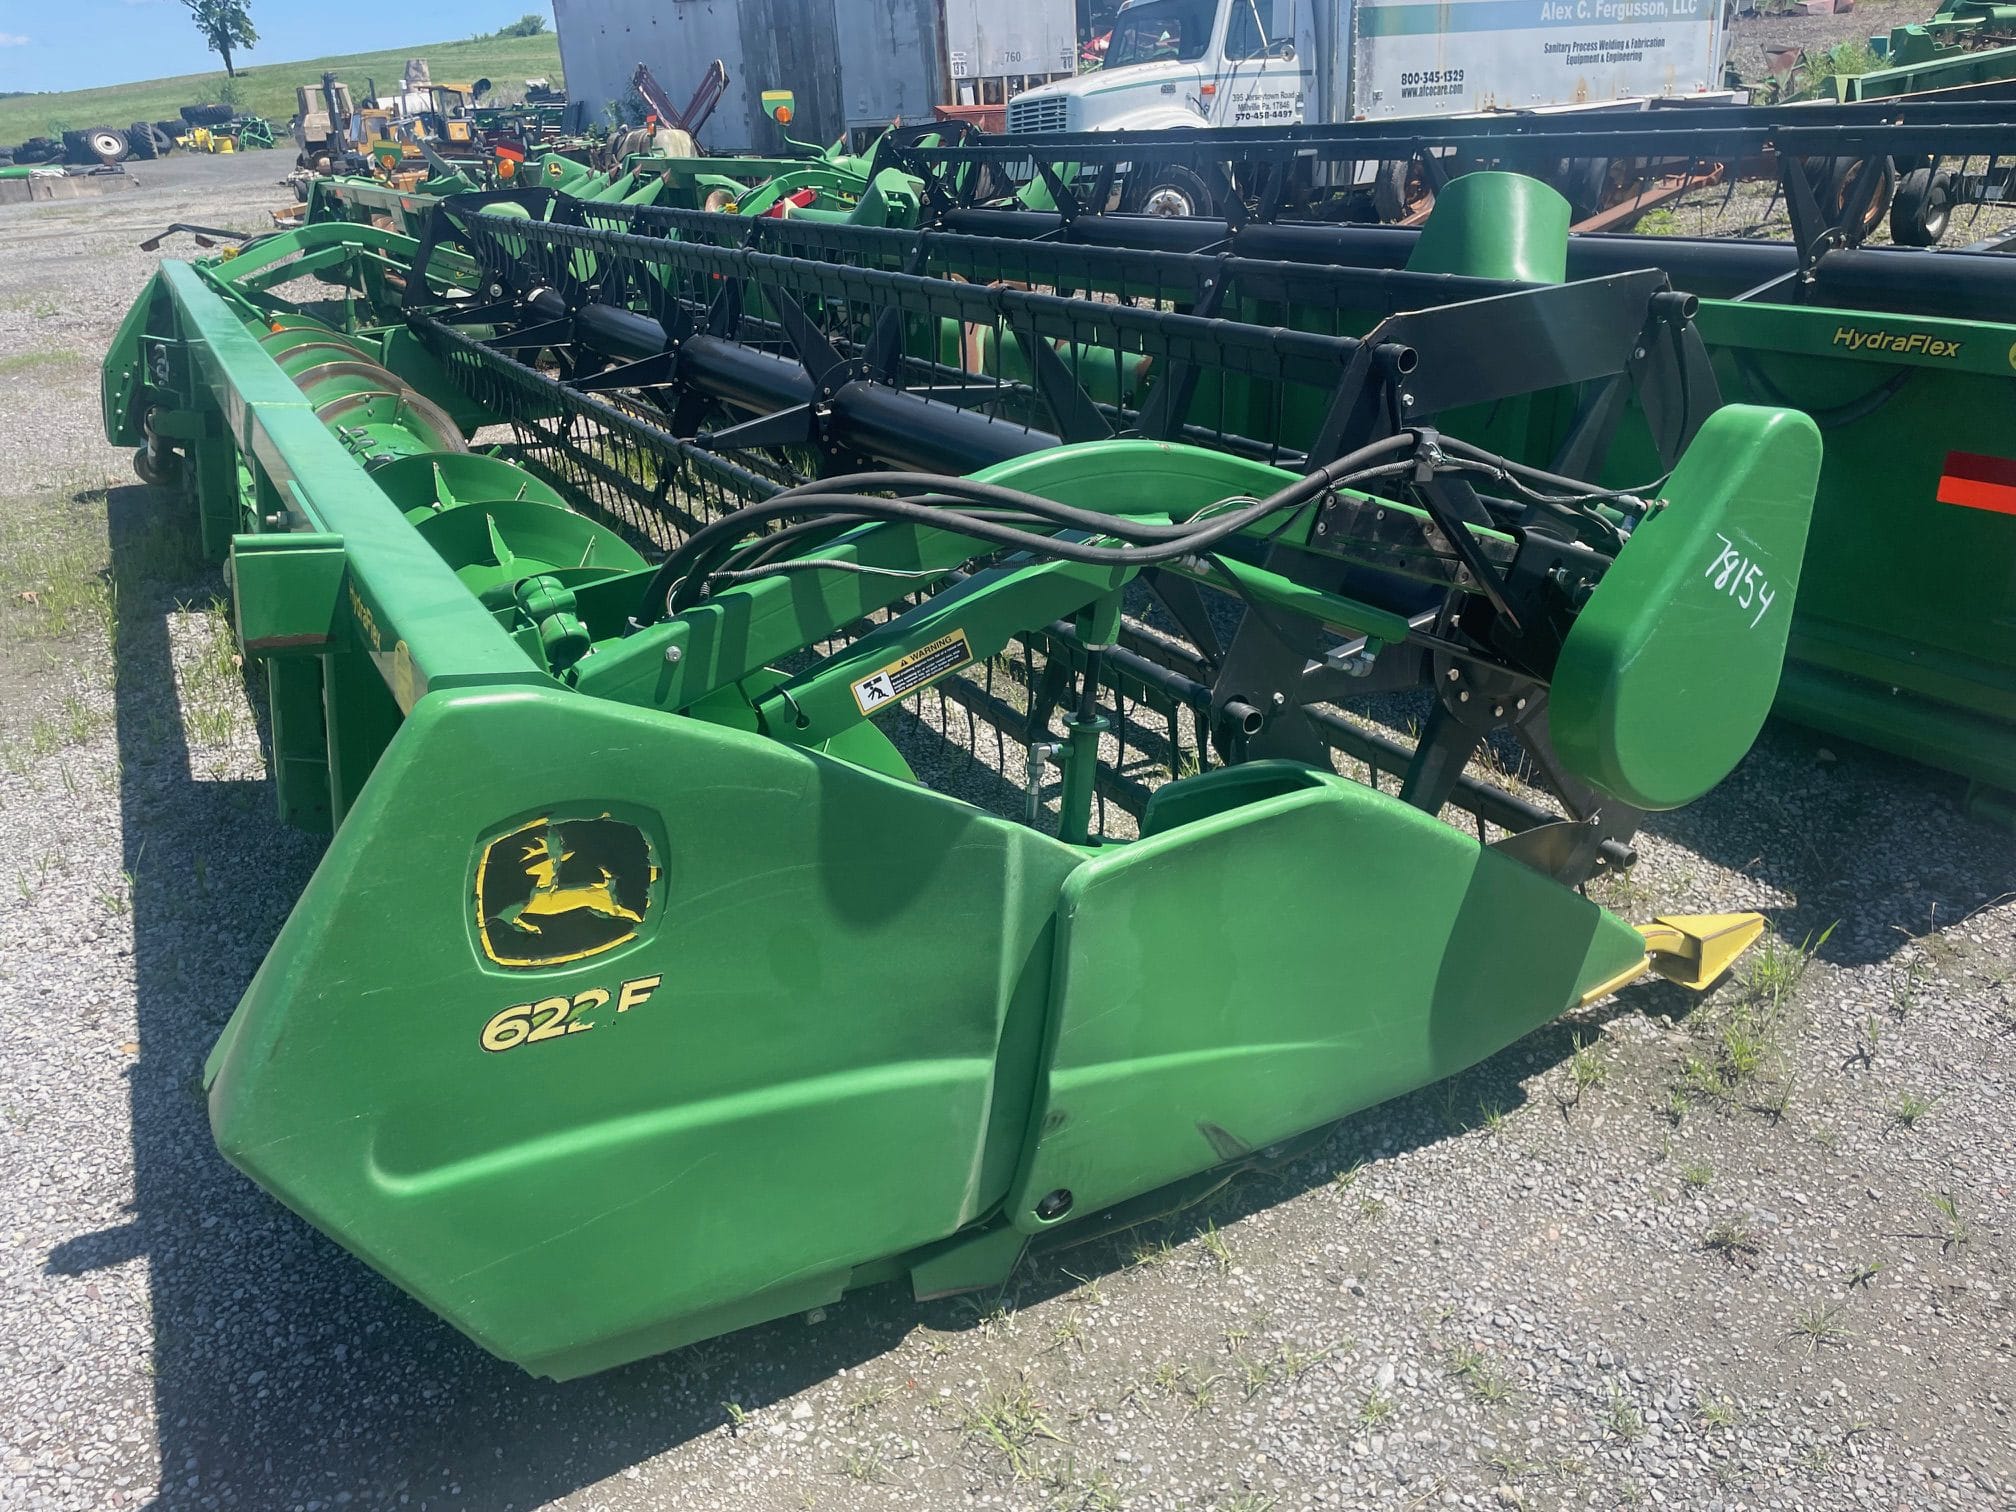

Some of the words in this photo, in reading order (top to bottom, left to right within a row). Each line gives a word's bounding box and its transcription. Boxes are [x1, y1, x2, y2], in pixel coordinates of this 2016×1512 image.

[1541, 1, 1573, 20] Alex
[1577, 0, 1591, 19] C.
[1596, 0, 1669, 20] Fergusson,
[1672, 0, 1697, 14] LLC
[1544, 42, 1571, 54] Sanitary
[1572, 41, 1598, 52] Process
[1599, 39, 1625, 51] Welding
[1631, 37, 1665, 49] Fabrication
[1005, 51, 1021, 62] 760
[1566, 53, 1599, 65] Equipment
[1606, 51, 1643, 63] Engineering
[1401, 69, 1464, 85] 800-345-1329
[1401, 84, 1463, 98] www.afcocare.com
[1832, 327, 1961, 357] HydraFlex
[1705, 532, 1775, 629] 78154
[910, 636, 952, 661] WARNING
